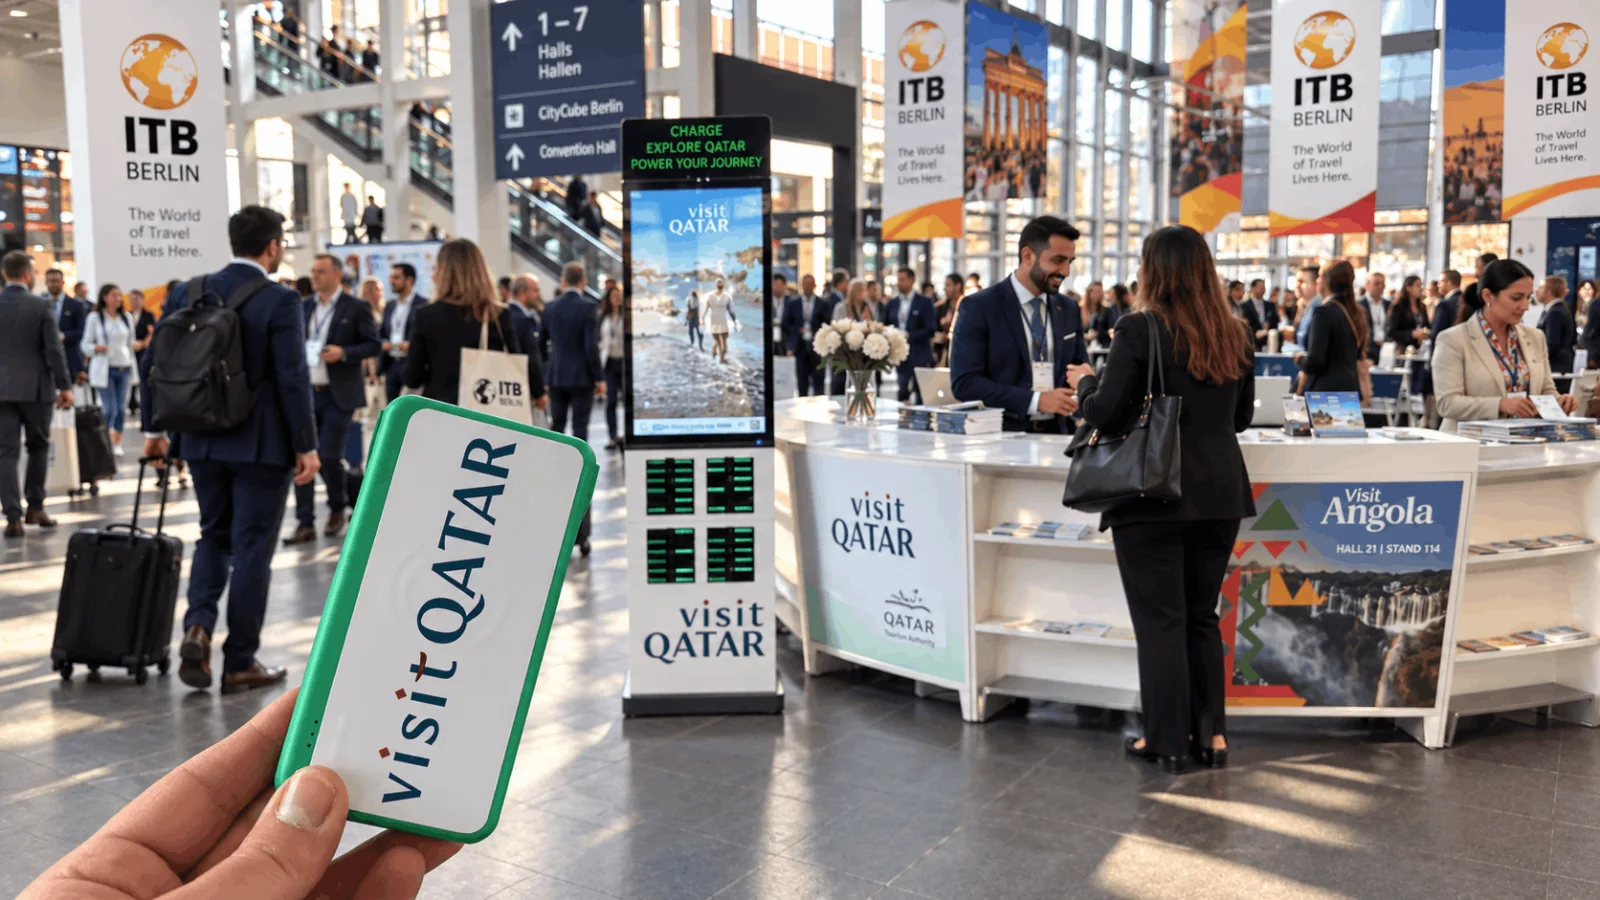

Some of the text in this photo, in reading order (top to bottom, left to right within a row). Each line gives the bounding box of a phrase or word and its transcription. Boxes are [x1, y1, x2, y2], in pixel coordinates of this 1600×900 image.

[538, 41, 573, 60] Halls
[538, 61, 581, 80] Hallen
[898, 75, 945, 105] ITB
[1293, 73, 1353, 107] ITB
[1536, 72, 1587, 100] ITB
[538, 99, 623, 122] CityCube Berlin
[898, 107, 945, 125] BERLIN
[1535, 100, 1587, 117] BERLIN
[1293, 108, 1353, 127] BERLIN
[124, 116, 199, 156] ITB
[670, 124, 723, 138] CHARGE
[1535, 129, 1586, 142] The World
[539, 139, 616, 160] Convention Hall
[646, 140, 746, 155] EXPLORE QATAR
[898, 144, 945, 159] The World
[1293, 141, 1352, 157] The World
[1535, 142, 1578, 154] of Travel
[631, 156, 763, 170] POWER YOUR JOURNEY
[897, 159, 937, 172] of Travel
[1293, 156, 1343, 170] of Travel
[1535, 153, 1586, 165] Lives Here.
[126, 161, 200, 182] BERLIN
[897, 173, 945, 186] Lives Here.
[1292, 170, 1352, 185] Lives Here.
[128, 207, 201, 222] The World
[688, 203, 727, 218] visit
[129, 225, 190, 240] of Travel
[669, 218, 730, 235] QATAR
[130, 243, 202, 258] Lives Here.
[499, 381, 522, 397] ITB
[1345, 488, 1382, 503] Visit
[851, 491, 905, 523] visit
[1320, 496, 1434, 533] Angola
[831, 518, 916, 559] QATAR
[1336, 544, 1363, 554] HALL
[1365, 544, 1377, 553] 21
[1386, 544, 1421, 553] STAND
[1424, 544, 1441, 553] 114
[378, 437, 517, 803] visit QATAR
[679, 599, 764, 628] visit
[884, 611, 935, 634] QATAR
[644, 630, 765, 664] QATAR
[908, 635, 935, 648] Authority
